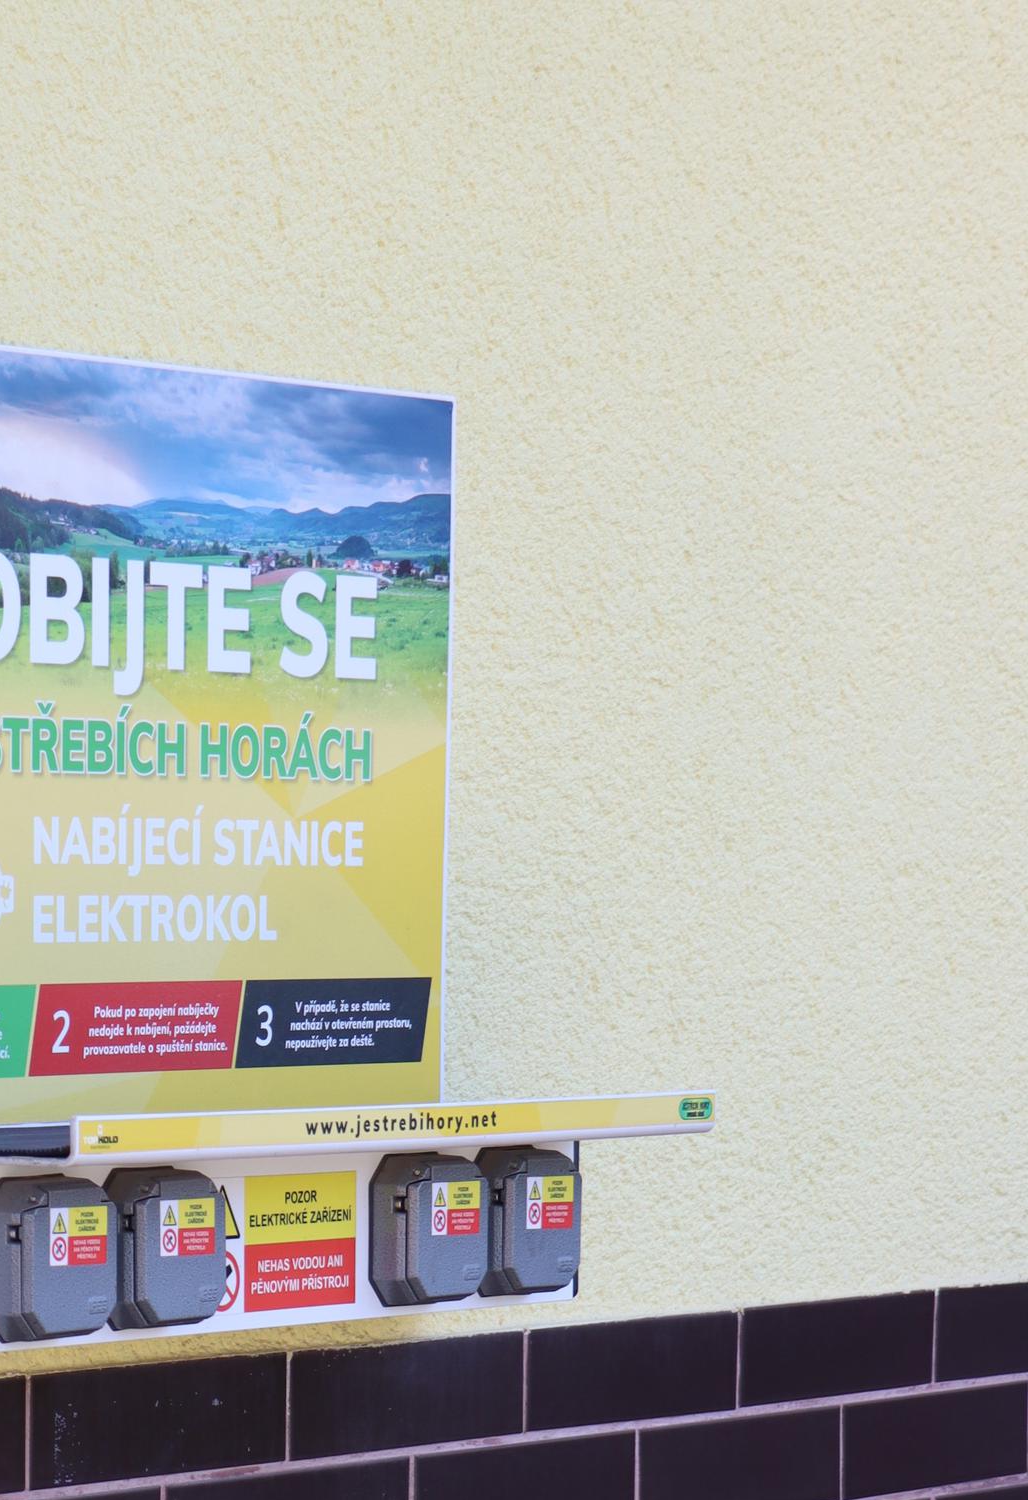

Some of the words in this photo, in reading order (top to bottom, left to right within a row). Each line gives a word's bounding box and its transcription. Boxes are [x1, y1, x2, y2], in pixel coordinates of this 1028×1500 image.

[280, 570, 378, 680] SE
[200, 712, 372, 783] HORÁCH
[33, 804, 204, 877] NABÍJECÍ
[214, 819, 364, 867] STANICE
[33, 895, 277, 943] ELEKTROKOL
[94, 1006, 122, 1019] Pokud
[125, 1008, 136, 1020] po
[139, 1003, 175, 1020] zapojení
[178, 1003, 219, 1018] nabíječky
[296, 1001, 302, 1013] V
[304, 1000, 337, 1016] případě,
[340, 1000, 349, 1012] že
[351, 1003, 360, 1012] se
[362, 1000, 390, 1012] stanice
[52, 1010, 70, 1054] 2
[89, 1024, 124, 1039] nedojde
[127, 1023, 132, 1035] k
[135, 1022, 171, 1038] nabíjení,
[174, 1022, 216, 1036] požádejte
[255, 1005, 273, 1046] 3
[290, 1017, 322, 1031] nachází
[325, 1021, 329, 1030] v
[332, 1017, 373, 1030] otevřeném
[376, 1018, 412, 1032] prostoru,
[84, 1041, 145, 1059] provozovatele
[148, 1044, 153, 1053] o
[156, 1041, 193, 1056] spuštění
[194, 1039, 227, 1052] stanice.
[285, 1037, 337, 1051] nepoužívejte
[339, 1039, 348, 1048] za
[351, 1035, 374, 1047] deště.
[305, 1111, 496, 1137] www.jestrebihory.net
[285, 1190, 317, 1204] POZOR
[249, 1208, 308, 1228] ELEKTRICKÉ
[310, 1204, 352, 1223] ZAŘÍZENÍ
[257, 1258, 290, 1273] NEHAS
[292, 1255, 326, 1270] VODOU
[327, 1254, 343, 1268] ANI
[251, 1276, 300, 1295] PĚNOVÝMI
[302, 1274, 349, 1290] PŘÍSTROJI
